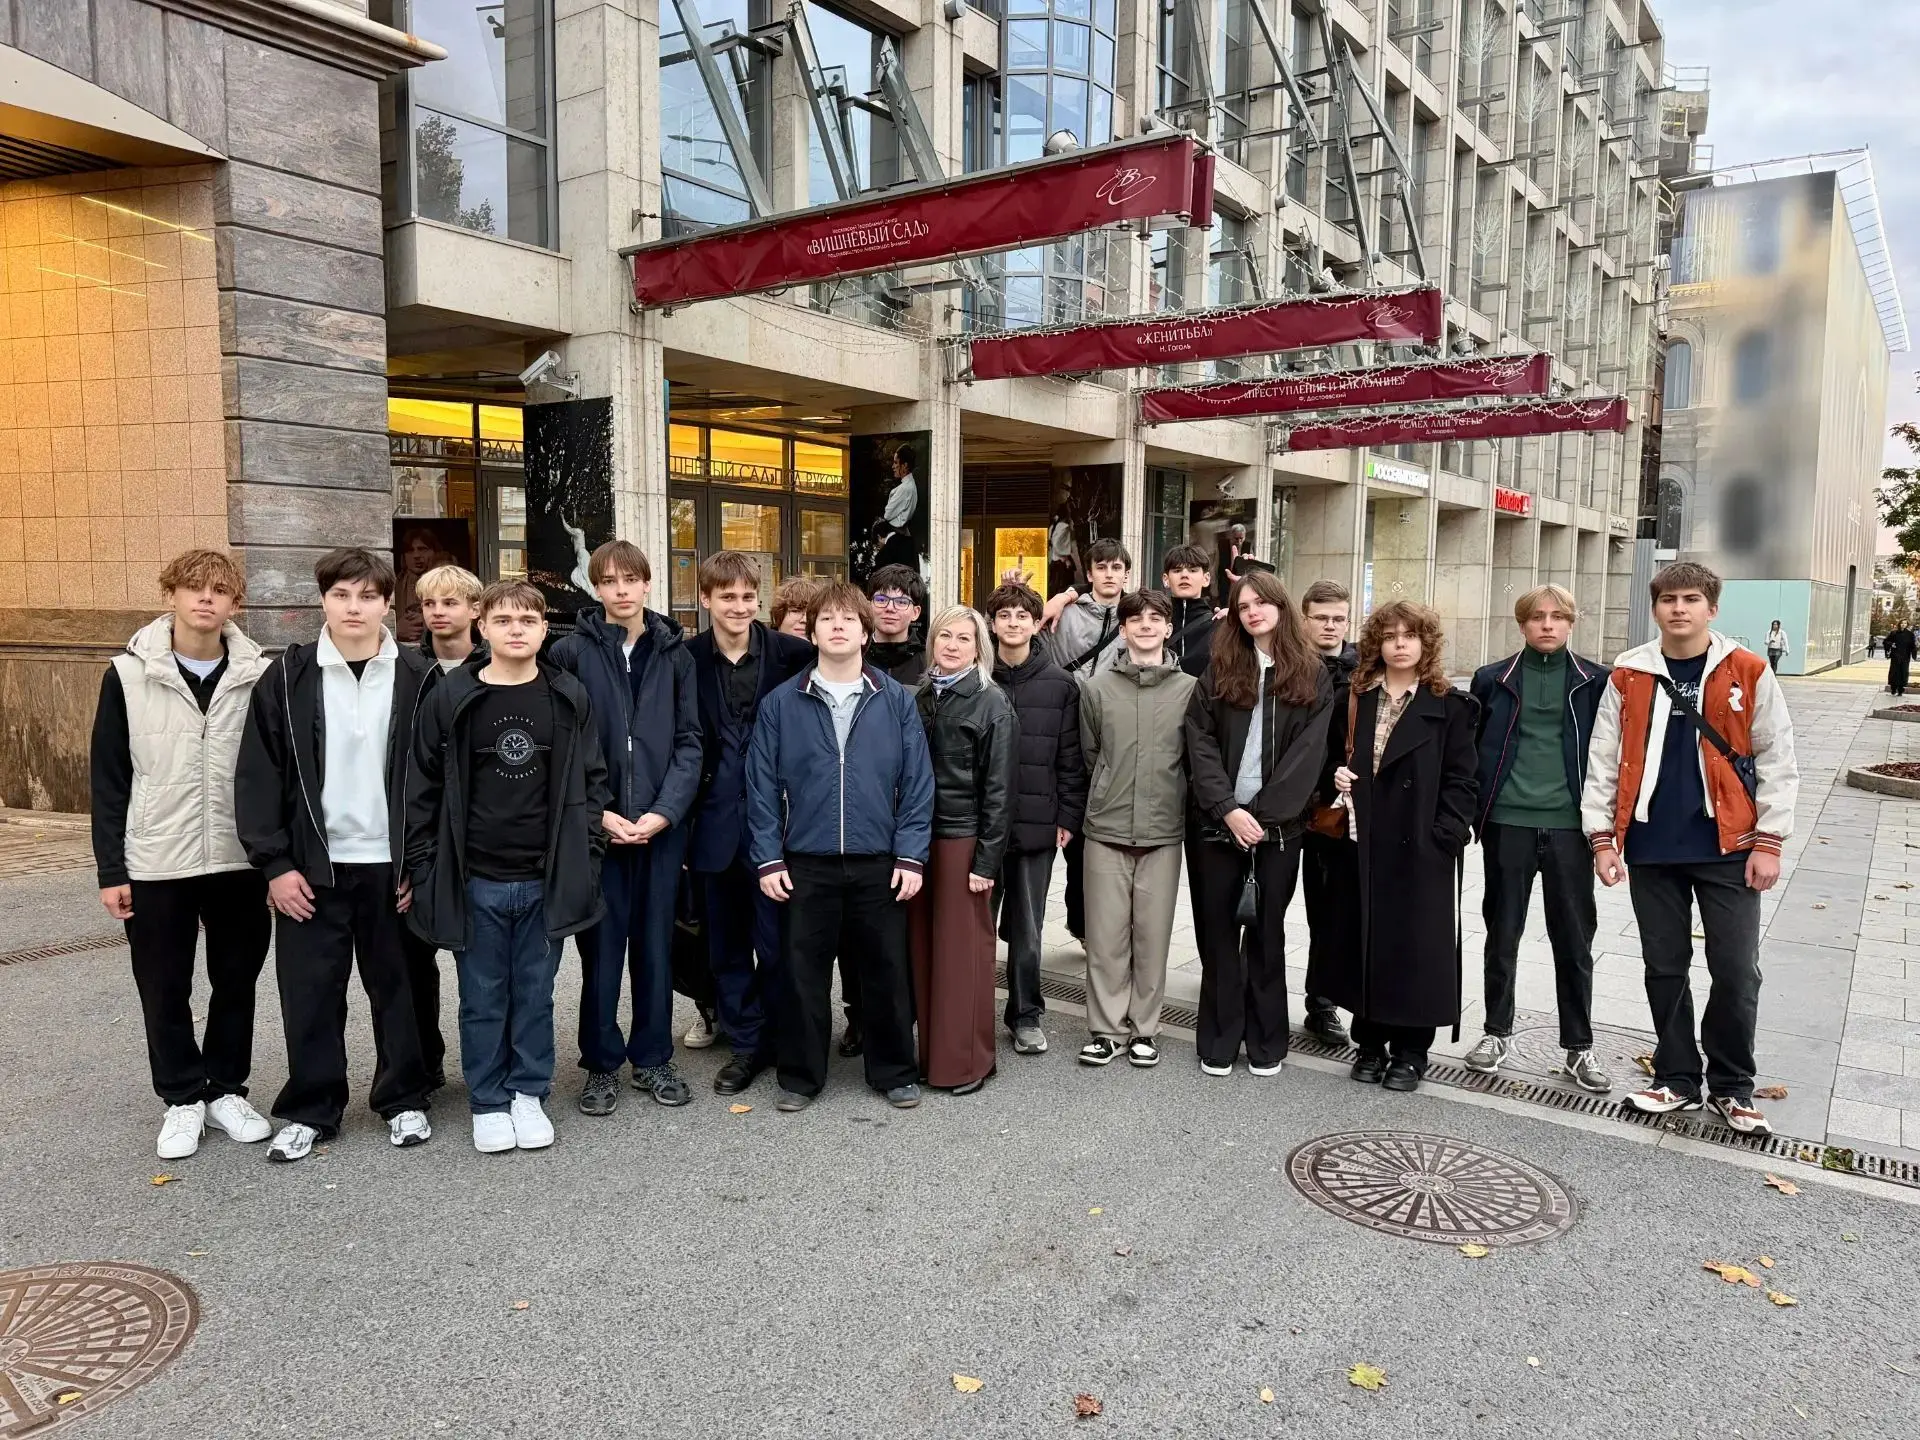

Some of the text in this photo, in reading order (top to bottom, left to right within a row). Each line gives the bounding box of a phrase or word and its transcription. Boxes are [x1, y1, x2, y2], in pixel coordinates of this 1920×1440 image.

[807, 220, 929, 255] «ВИШНЕВЫЙ САД»
[1136, 325, 1213, 344] «ЖЕНИТЬБА»
[1168, 343, 1191, 352] Гоголь
[1244, 381, 1326, 399] «ПРЕСТУПЛЕНИЕ
[1328, 381, 1336, 392] И
[1307, 392, 1347, 402] Достоевский
